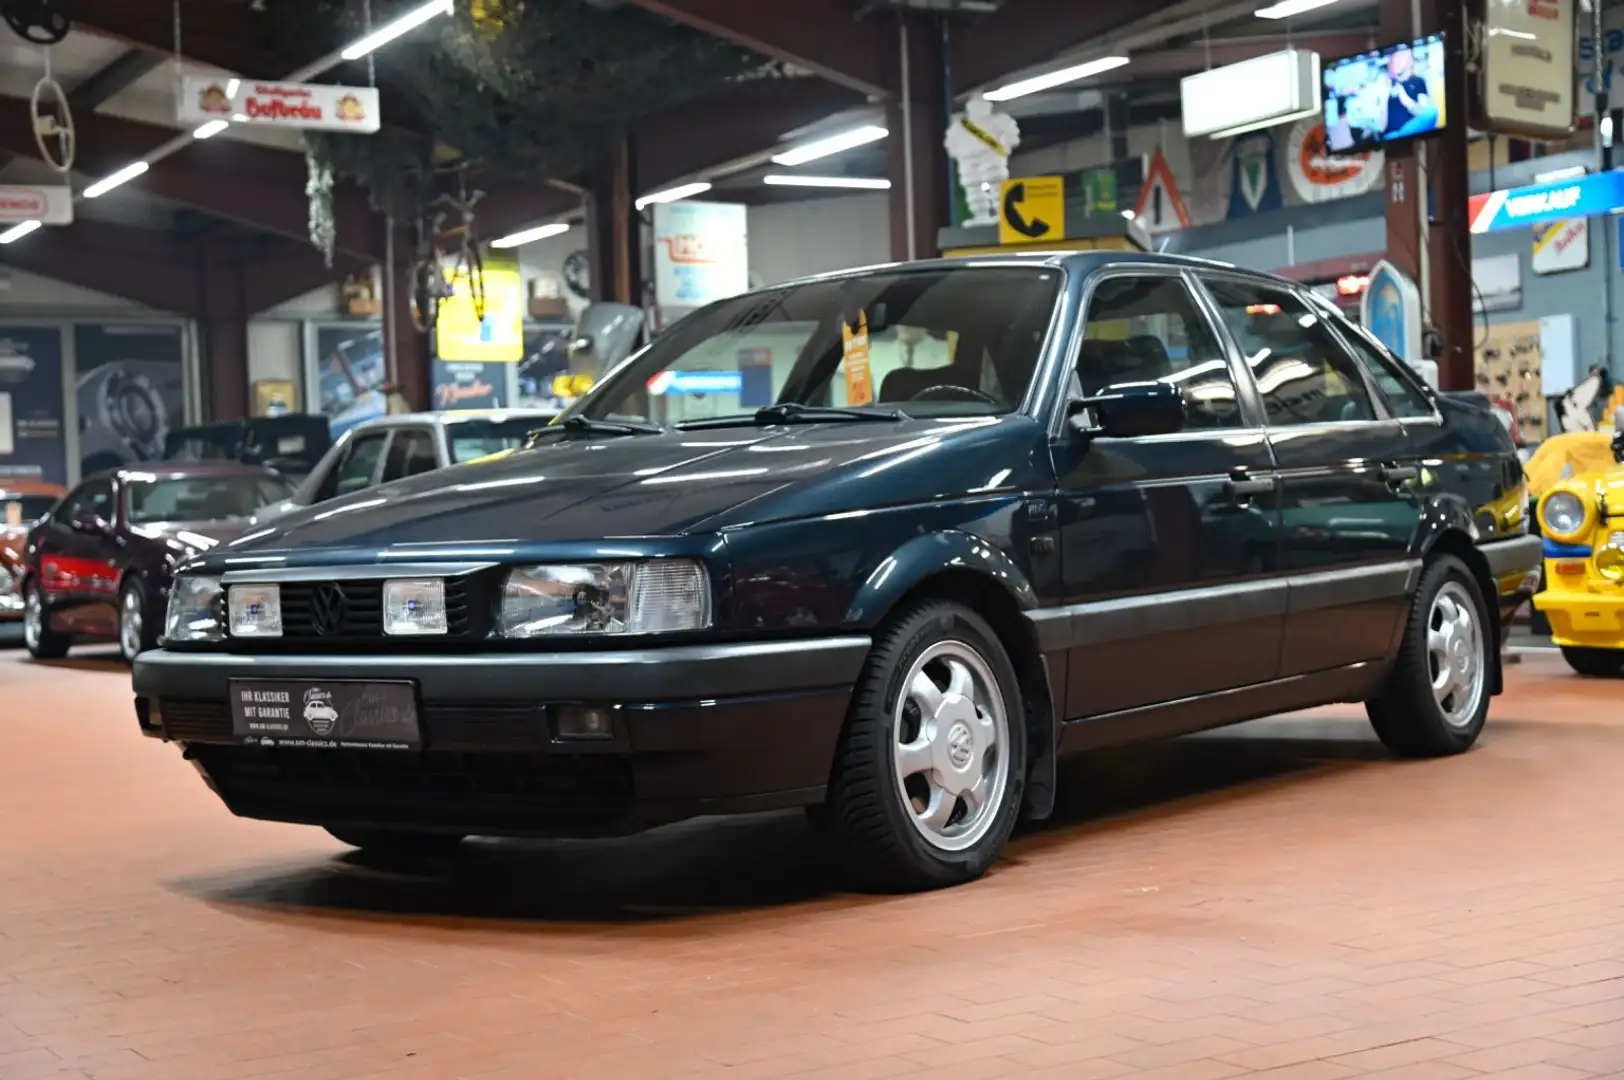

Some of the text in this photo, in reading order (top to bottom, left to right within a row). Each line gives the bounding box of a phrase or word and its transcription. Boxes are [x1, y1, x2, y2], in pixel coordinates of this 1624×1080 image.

[240, 690, 253, 702] IHR
[254, 691, 290, 703] KLASSIKER
[244, 706, 290, 719] MIT GARANTIE
